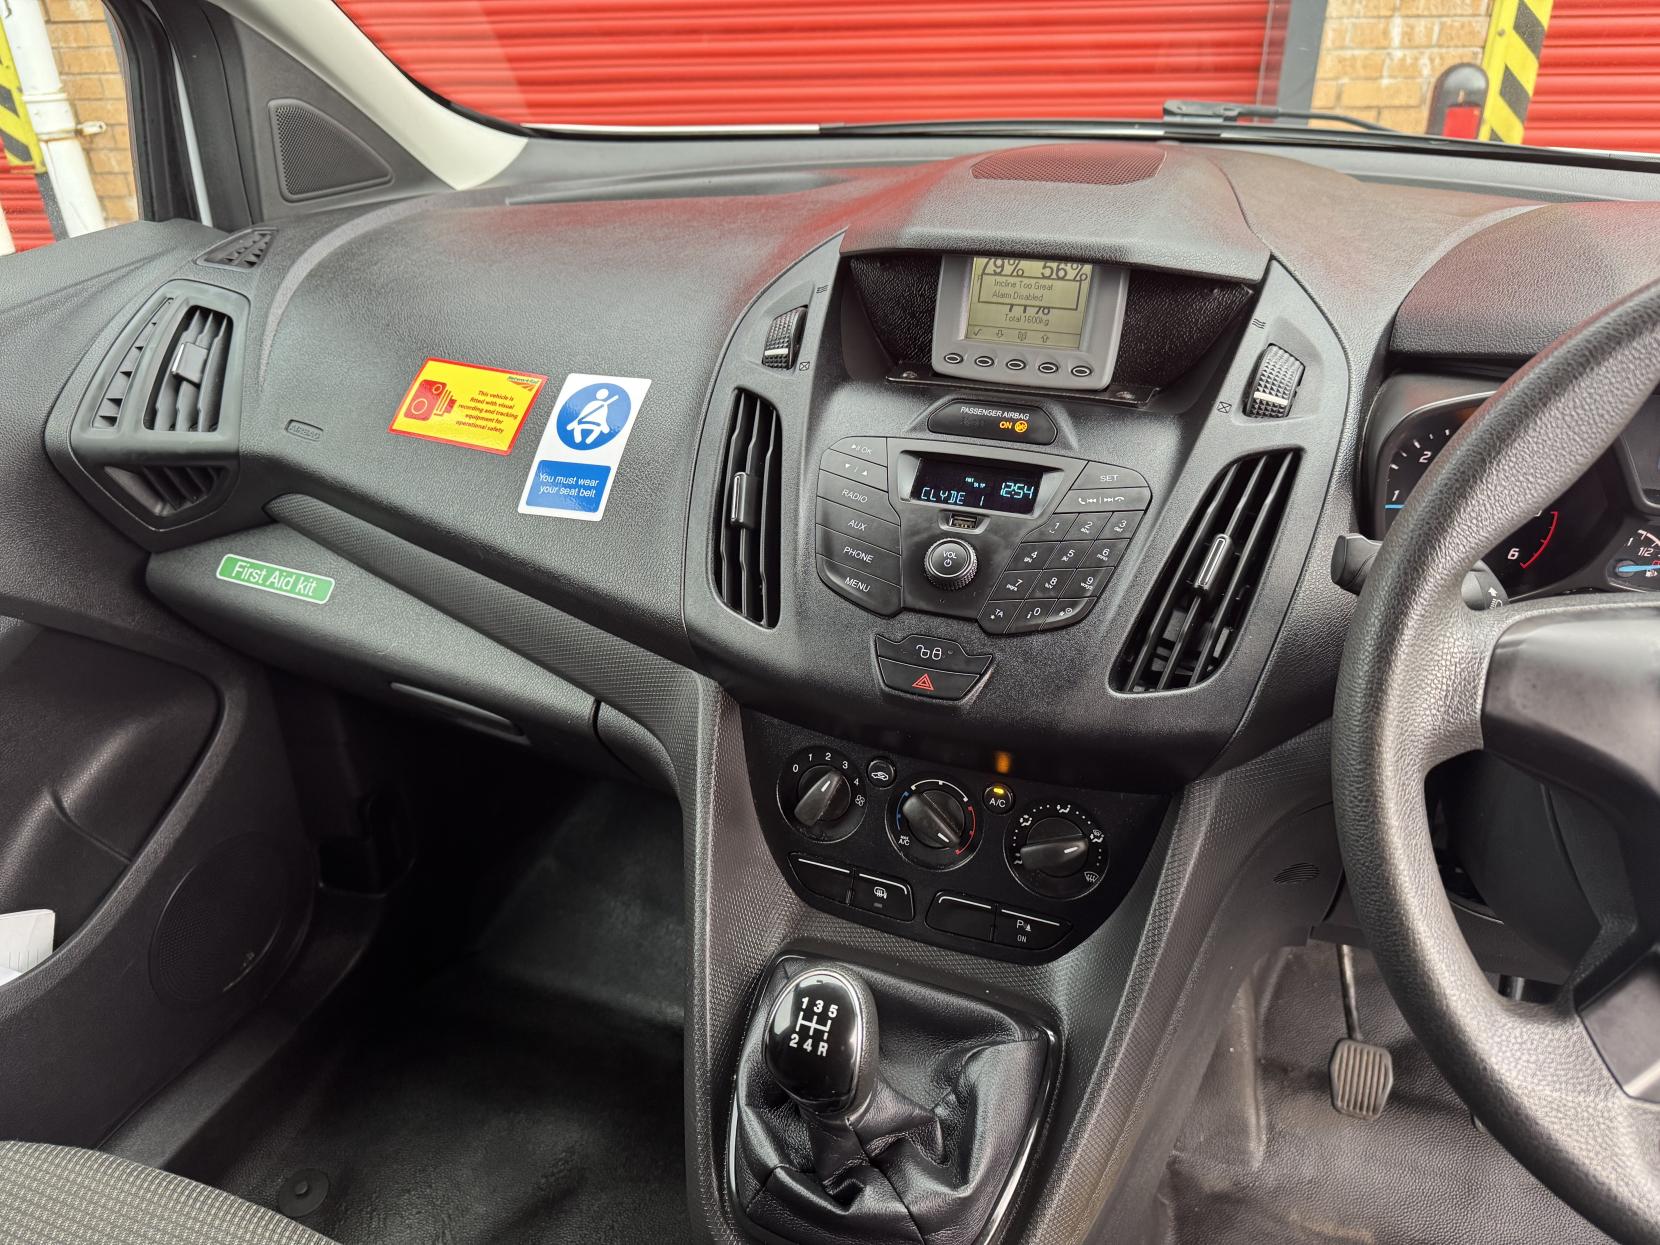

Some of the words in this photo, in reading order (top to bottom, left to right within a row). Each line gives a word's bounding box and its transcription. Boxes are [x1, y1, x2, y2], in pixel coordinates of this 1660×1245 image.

[1041, 261, 1088, 281] 56%
[994, 280, 1017, 288] Incline
[1019, 281, 1032, 289] Too
[1034, 282, 1054, 290] Great
[992, 290, 1012, 298] Alarm
[1013, 292, 1043, 301] Disabled
[458, 404, 483, 413] recording
[496, 411, 518, 420] tracking
[960, 407, 1001, 417] PASSENGER
[1003, 412, 1030, 420] AIRBAG
[465, 414, 494, 422] equipment
[456, 421, 487, 430] operational
[1419, 451, 1432, 463] 2
[539, 473, 554, 482] You
[556, 476, 576, 484] must
[539, 486, 558, 494] your
[560, 487, 578, 496] seat
[580, 488, 596, 497] belt
[842, 489, 868, 503] RADIO
[921, 488, 966, 504] CLYDE
[1001, 482, 1034, 499] 12:54
[1392, 490, 1400, 501] 1
[848, 520, 867, 531] AUX
[844, 546, 874, 563] PHONE
[1508, 548, 1520, 560] 6
[1638, 547, 1654, 556] 1/2
[232, 561, 267, 584] First
[266, 570, 295, 590] Aid
[296, 577, 317, 596] kit
[845, 577, 870, 592] MENU
[995, 609, 1004, 618] TA
[808, 753, 812, 761] 1
[825, 752, 832, 760] 2
[793, 764, 799, 772] 0
[842, 761, 848, 769] 3
[854, 778, 859, 786] 4
[989, 797, 1006, 808] A/C
[1017, 934, 1026, 943] ON
[802, 997, 809, 1009] 1
[814, 1000, 824, 1012] 3
[828, 1004, 838, 1018] 5
[789, 1034, 799, 1048] 2
[803, 1039, 813, 1052] 4
[817, 1042, 828, 1056] R
